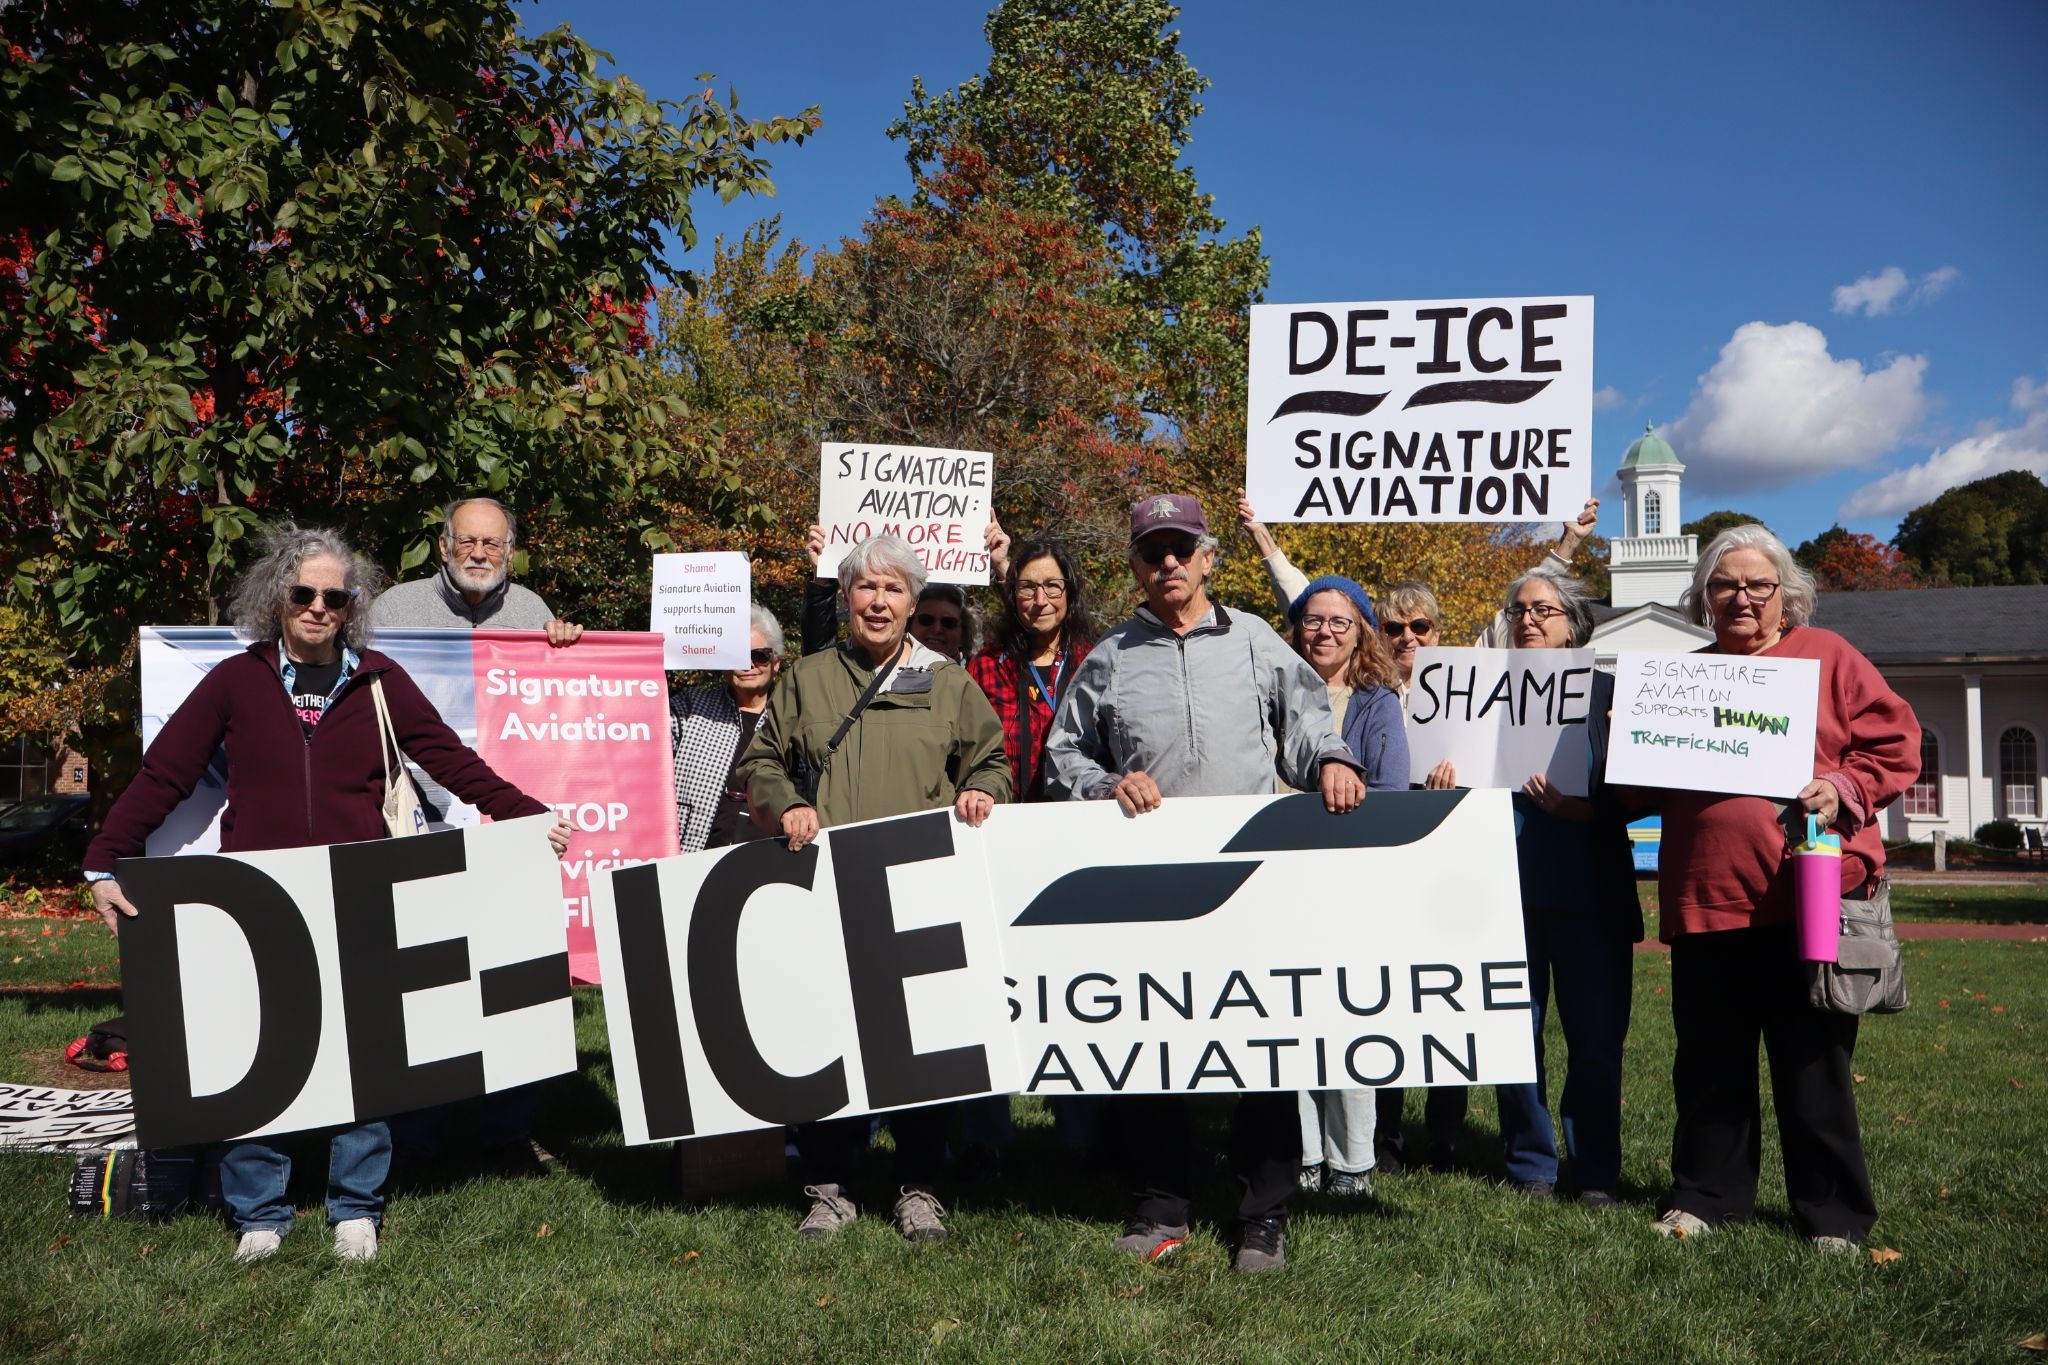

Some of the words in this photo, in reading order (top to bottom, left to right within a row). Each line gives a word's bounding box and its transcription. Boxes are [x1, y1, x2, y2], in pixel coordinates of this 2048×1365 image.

[1289, 304, 1567, 375] DE-ICE
[1295, 428, 1571, 472] SIGNATURE
[838, 449, 985, 488] SIGNATURE
[857, 489, 979, 520] AVIATION:
[1294, 473, 1548, 517] AVIATION
[830, 522, 871, 545] NO
[882, 523, 963, 545] MORE
[684, 563, 716, 574] Shame!
[703, 583, 741, 593] Aviation
[663, 604, 701, 616] supports
[704, 603, 735, 614] human
[674, 624, 722, 637] trafficking
[682, 645, 716, 655] Shame!
[1641, 660, 1778, 685] SIGNATURE
[486, 668, 660, 705] Signature
[1412, 662, 1591, 726] SHAME
[1636, 682, 1731, 703] AVIATION
[1631, 702, 1708, 718] SUPPORTS
[500, 712, 650, 741] Aviation
[74, 770, 83, 781] 25
[543, 802, 629, 832] TOP
[1026, 1032, 1479, 1092] AVIATION
